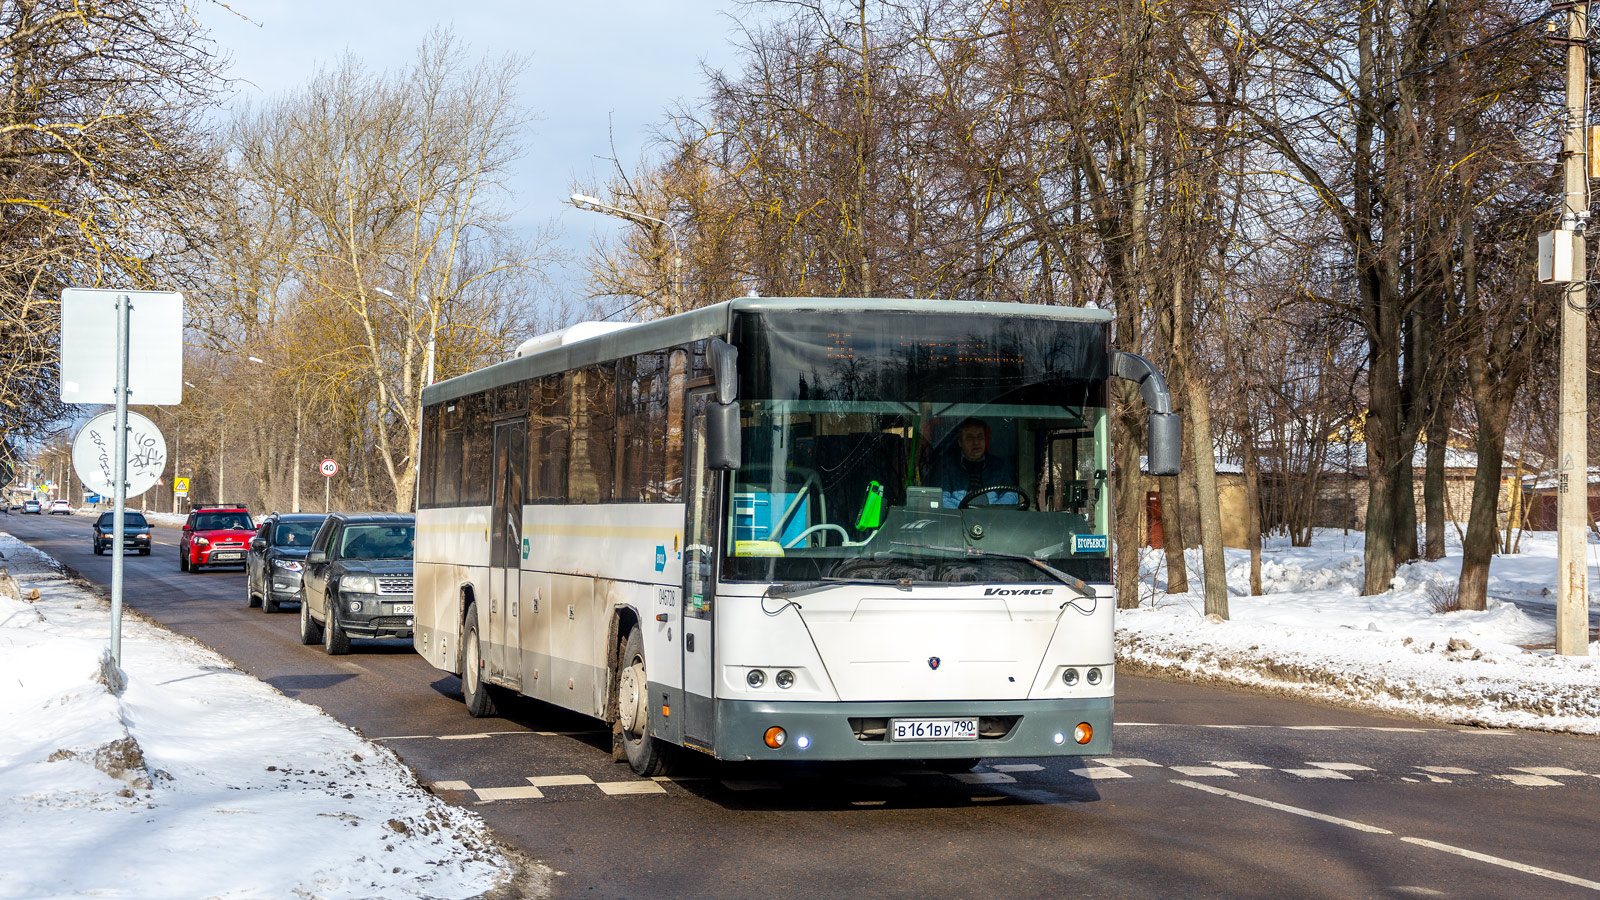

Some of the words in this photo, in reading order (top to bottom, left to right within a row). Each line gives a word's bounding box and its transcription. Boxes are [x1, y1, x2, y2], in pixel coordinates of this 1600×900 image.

[1077, 538, 1106, 548] ЕГОРЬЕВСК
[984, 588, 1054, 596] VOYAGE
[954, 721, 974, 732] 790
